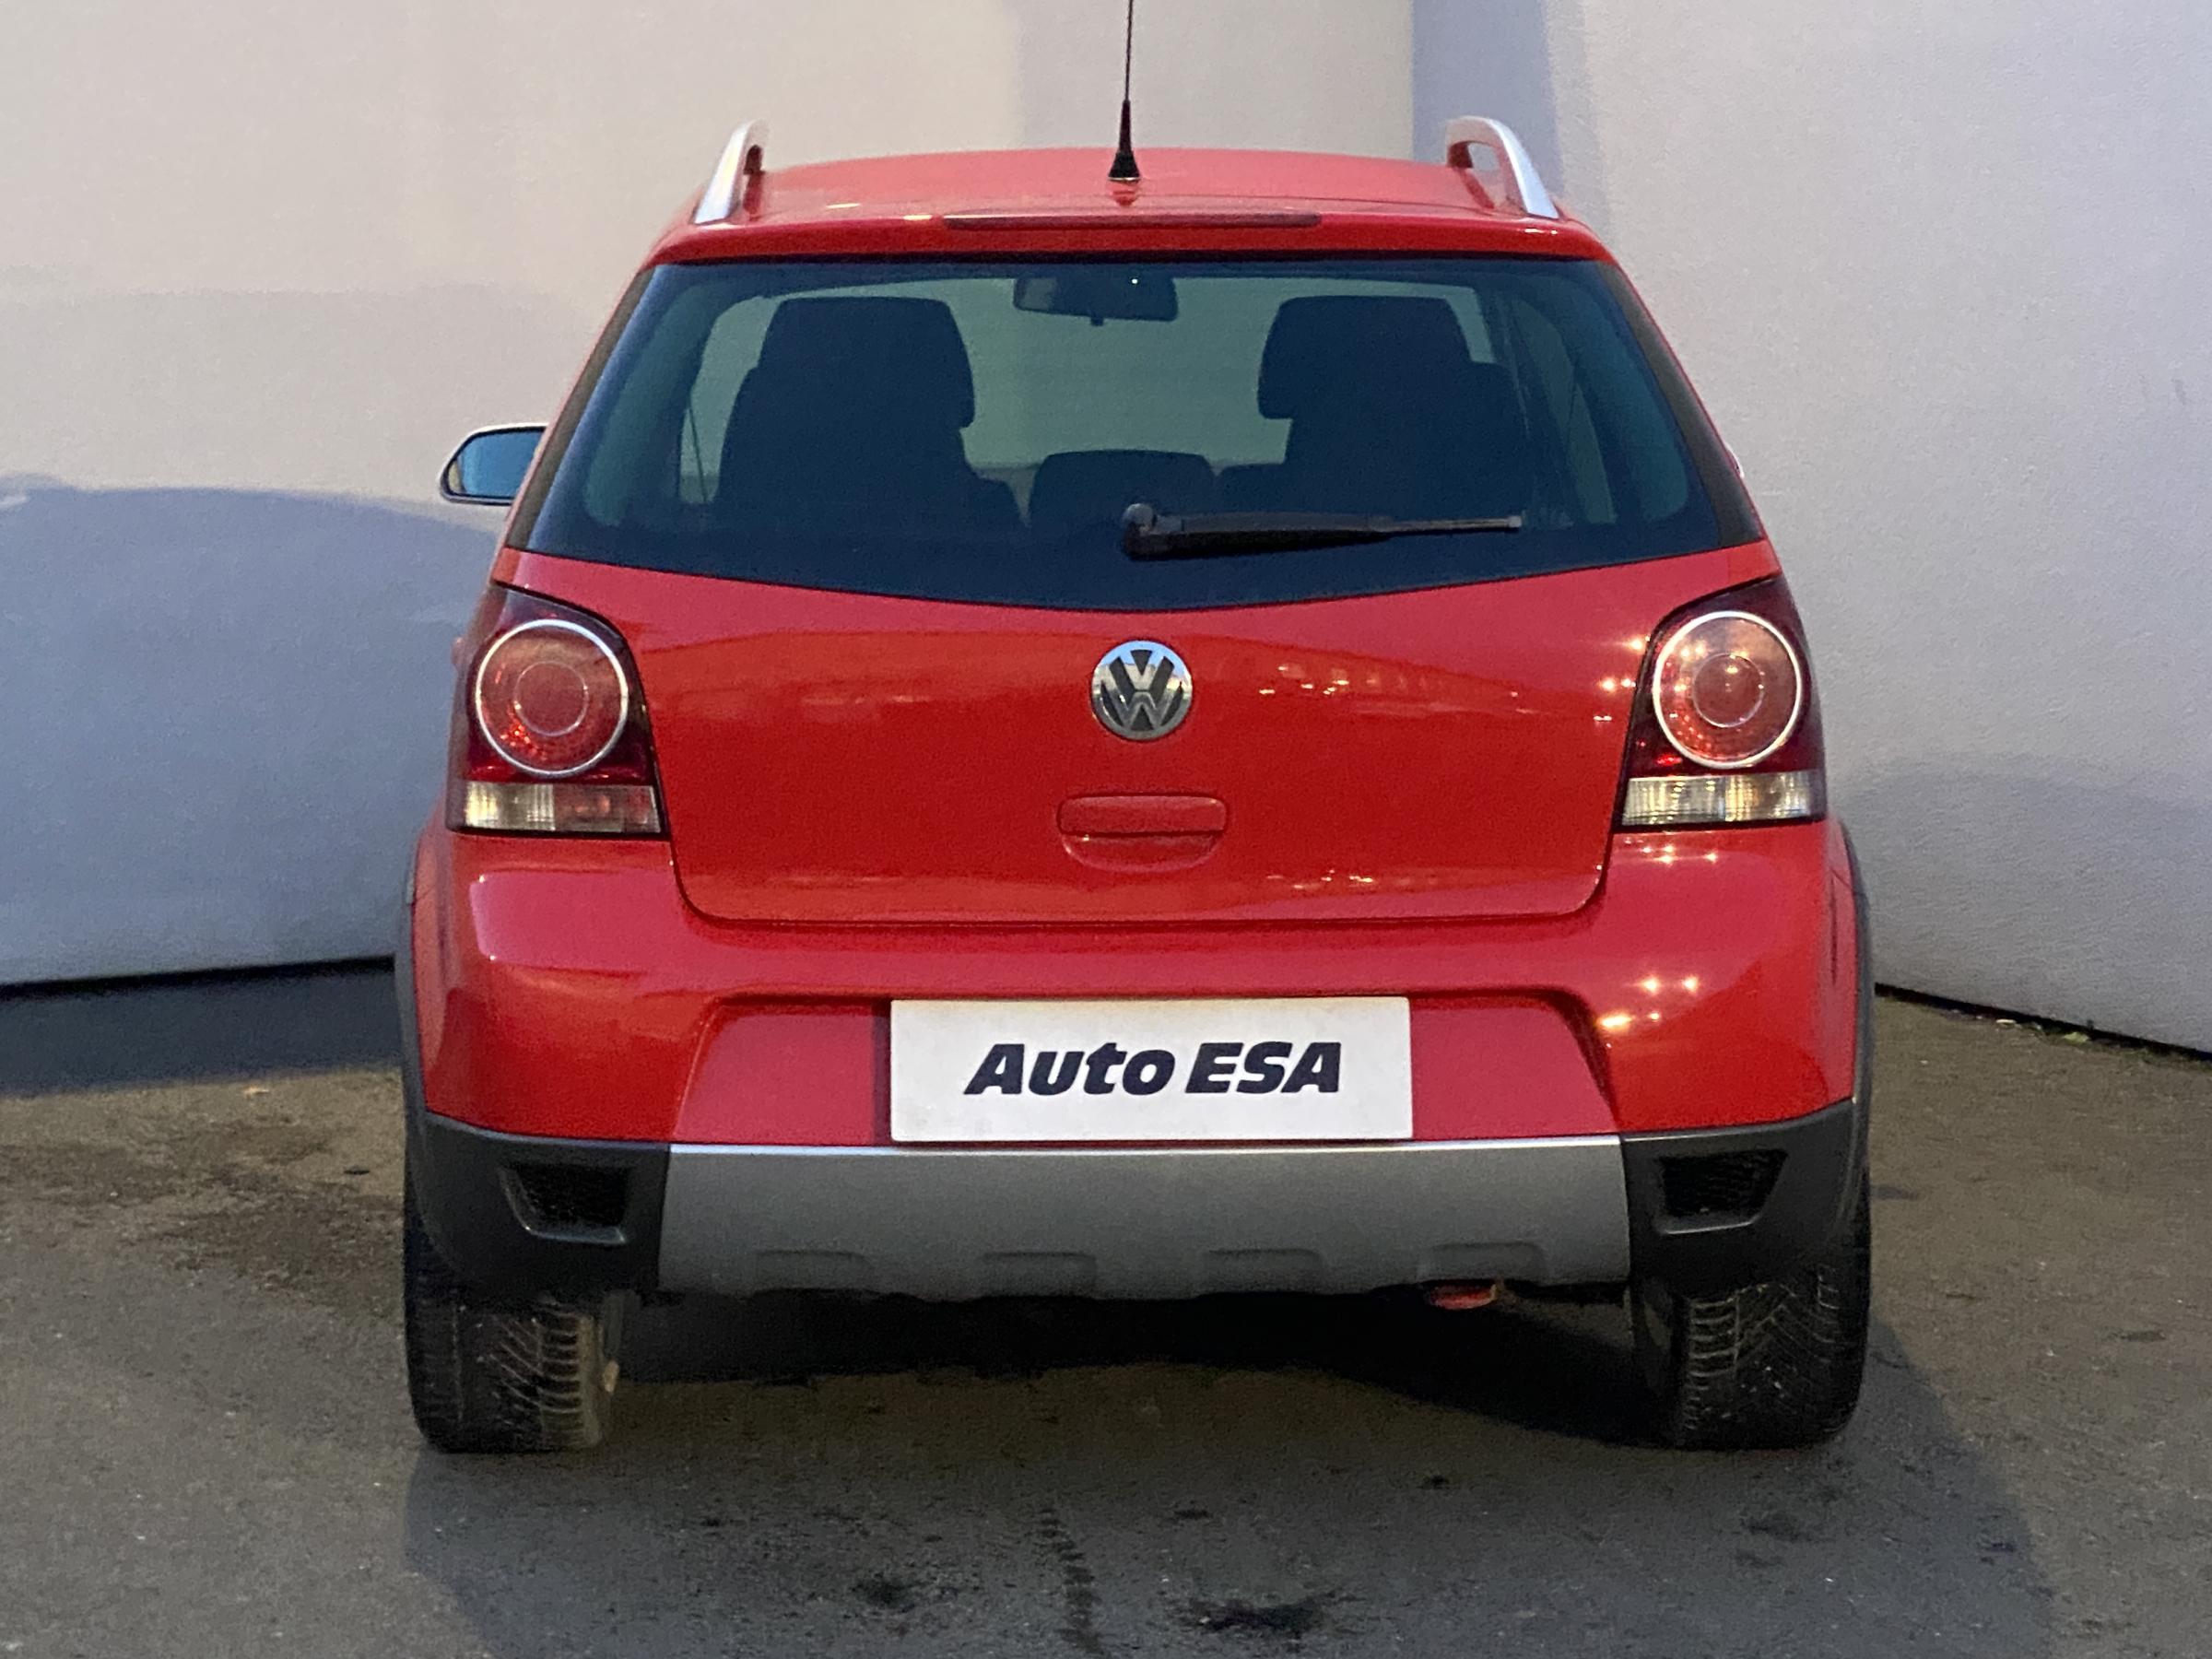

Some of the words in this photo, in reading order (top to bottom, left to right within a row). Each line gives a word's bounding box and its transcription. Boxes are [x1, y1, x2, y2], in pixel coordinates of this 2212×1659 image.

[1093, 641, 1192, 739] VW
[963, 1042, 1176, 1096] Auto
[1184, 1041, 1342, 1095] ESA
